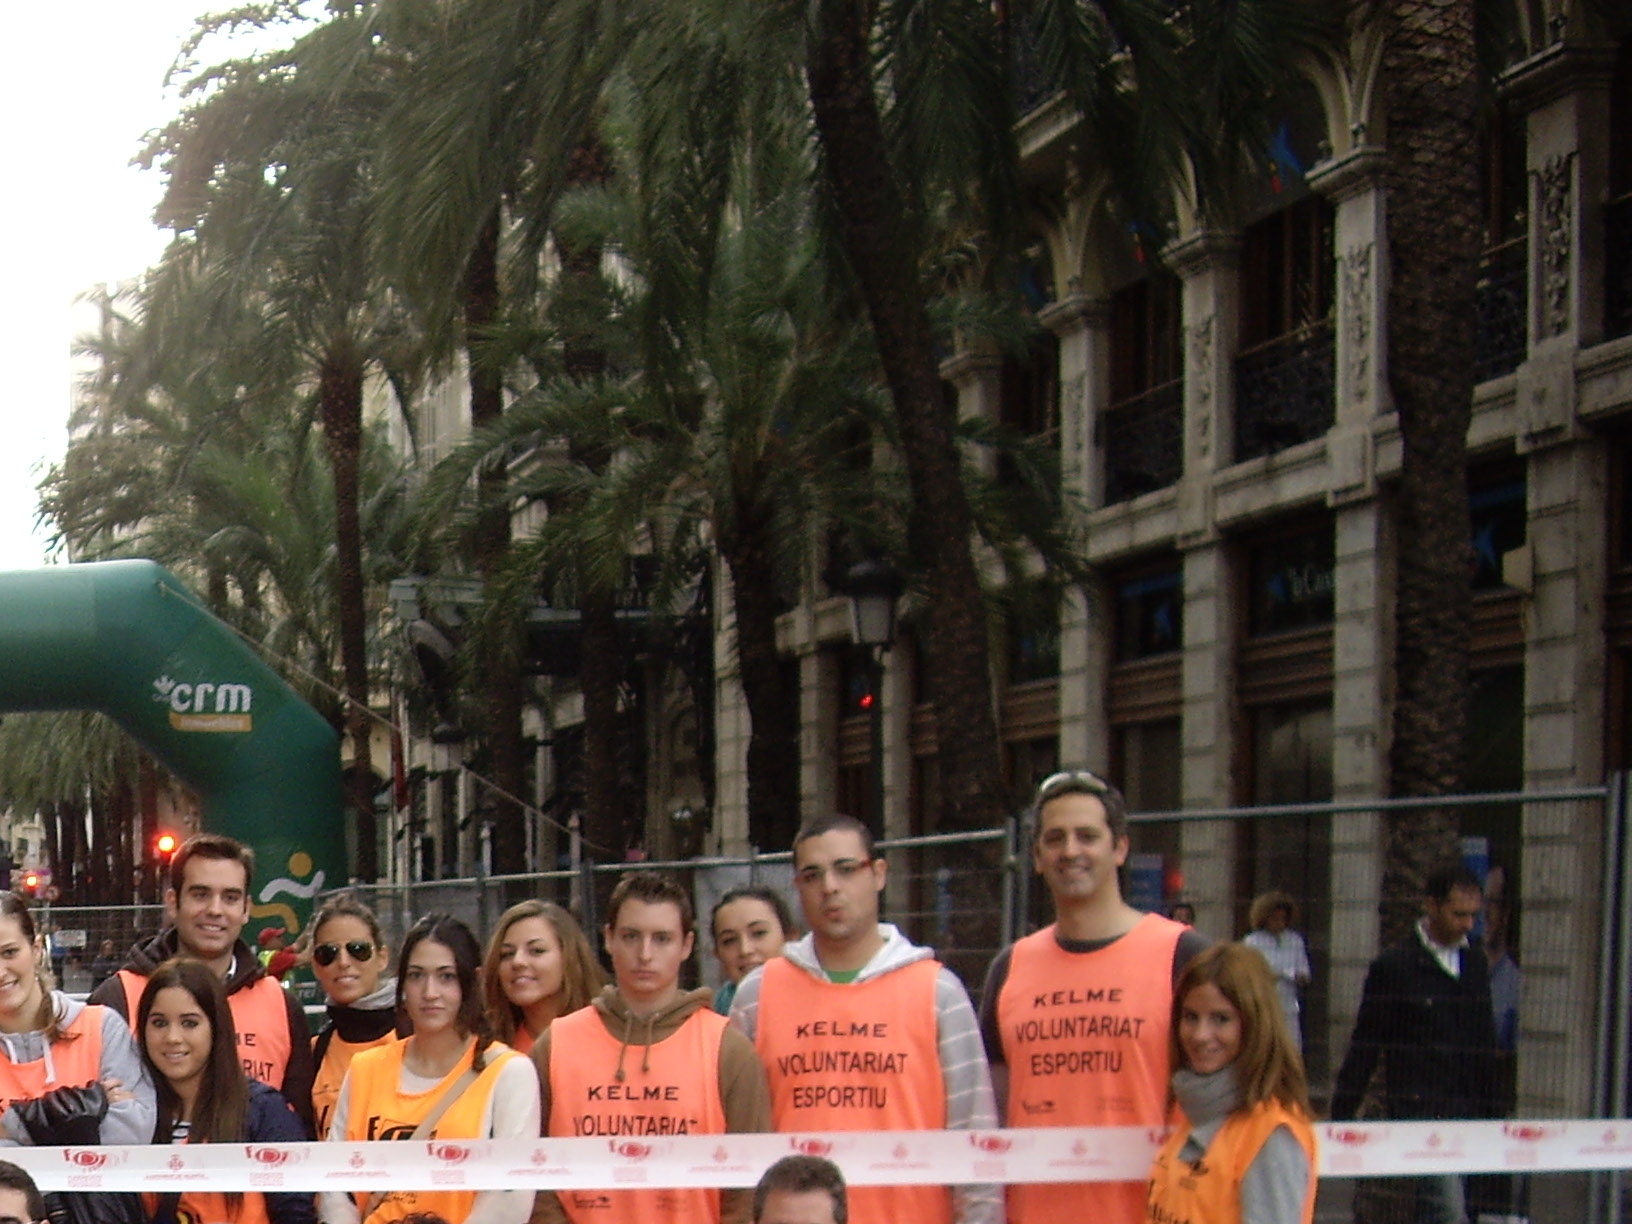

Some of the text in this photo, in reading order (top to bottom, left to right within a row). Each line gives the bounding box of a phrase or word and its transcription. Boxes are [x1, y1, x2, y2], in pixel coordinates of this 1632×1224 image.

[171, 683, 252, 712] crm
[1034, 989, 1123, 1008] KELME
[797, 1021, 888, 1039] KELME
[1016, 1016, 1145, 1043] VOLUNTARIAT
[778, 1052, 908, 1077] VOLUNTARIAT
[1031, 1051, 1124, 1076] ESPORTIU
[587, 1083, 680, 1101] KELME
[793, 1087, 887, 1109] ESPORTIU
